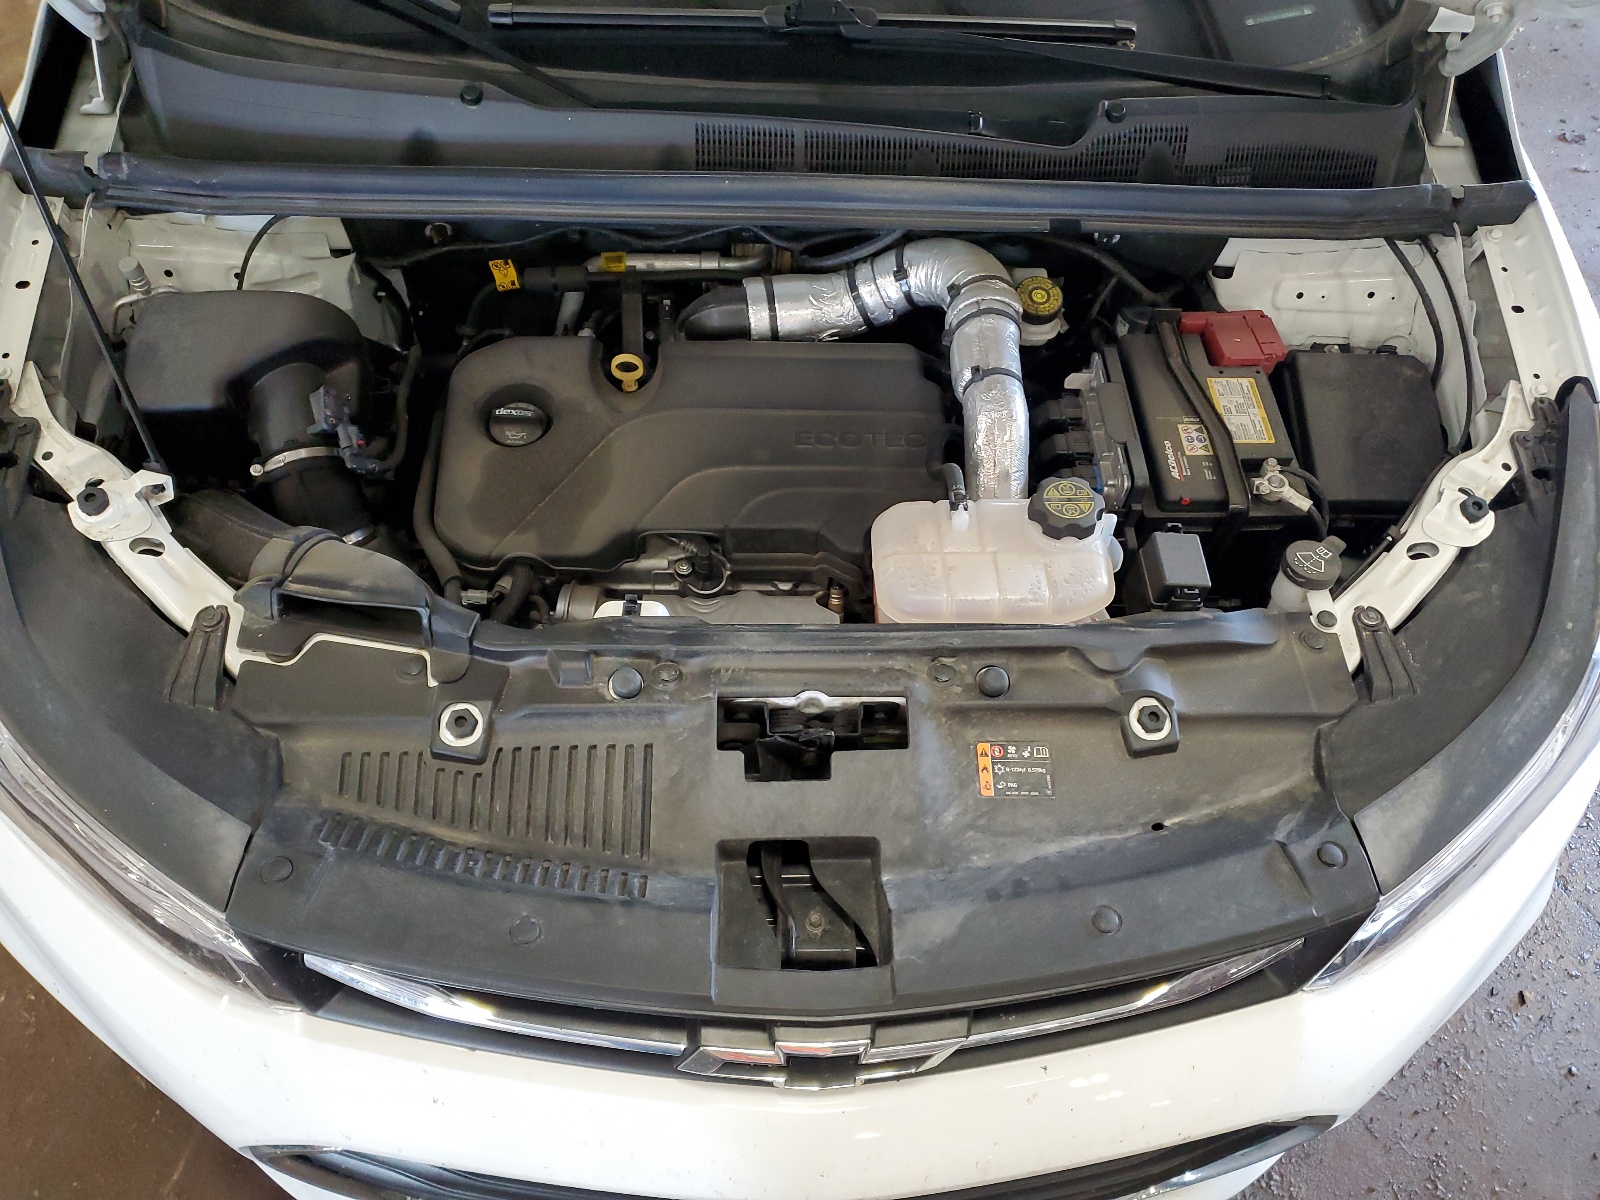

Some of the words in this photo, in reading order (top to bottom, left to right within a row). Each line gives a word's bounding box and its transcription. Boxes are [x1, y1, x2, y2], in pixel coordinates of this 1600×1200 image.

[495, 407, 532, 417] dexos
[793, 430, 926, 449] ECOTEC
[1163, 440, 1181, 480] ACDelco
